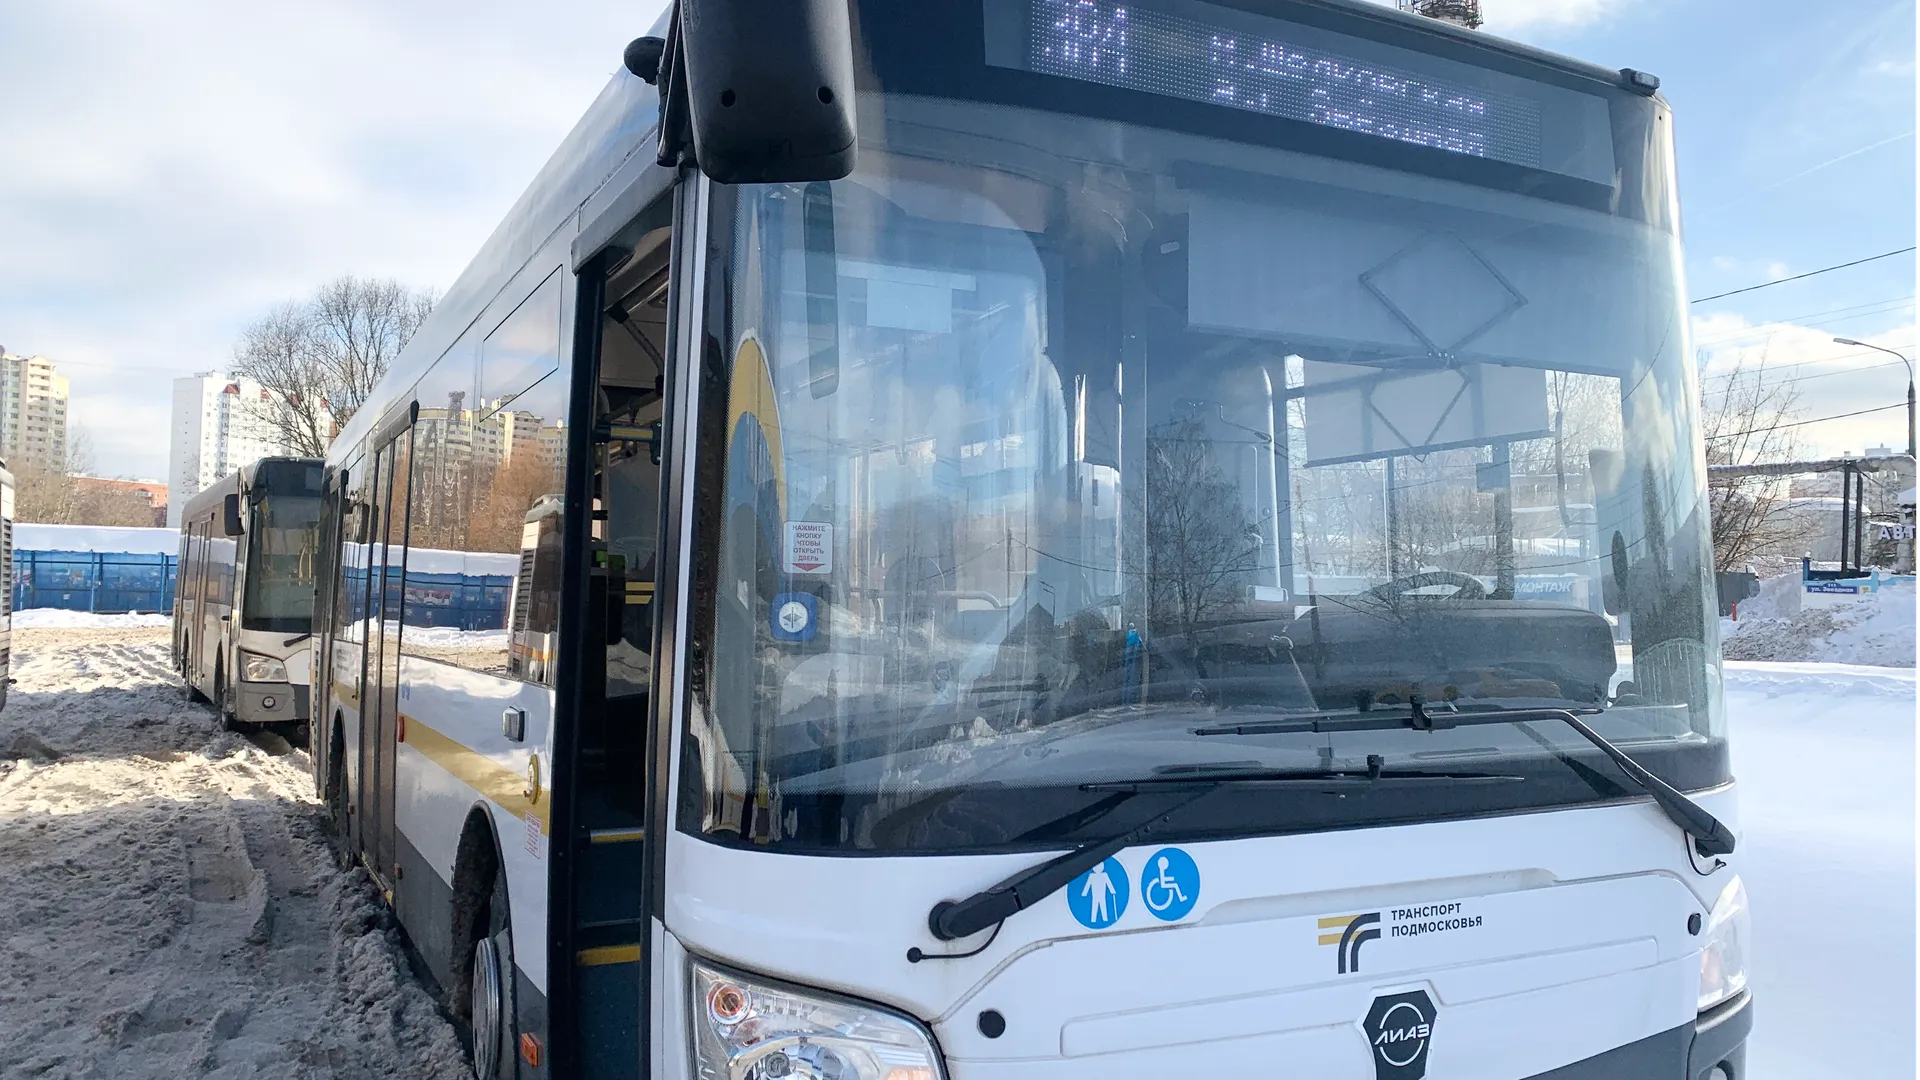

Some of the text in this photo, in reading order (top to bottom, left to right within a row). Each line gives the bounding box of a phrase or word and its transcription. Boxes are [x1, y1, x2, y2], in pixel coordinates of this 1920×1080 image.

[793, 547, 824, 555] ОТКРЫТЬ
[1391, 903, 1462, 921] ТРАНСПОРТ
[1391, 916, 1483, 937] ПОДМОСКОВЬЯ
[1375, 1023, 1430, 1046] ЛИАЗ
